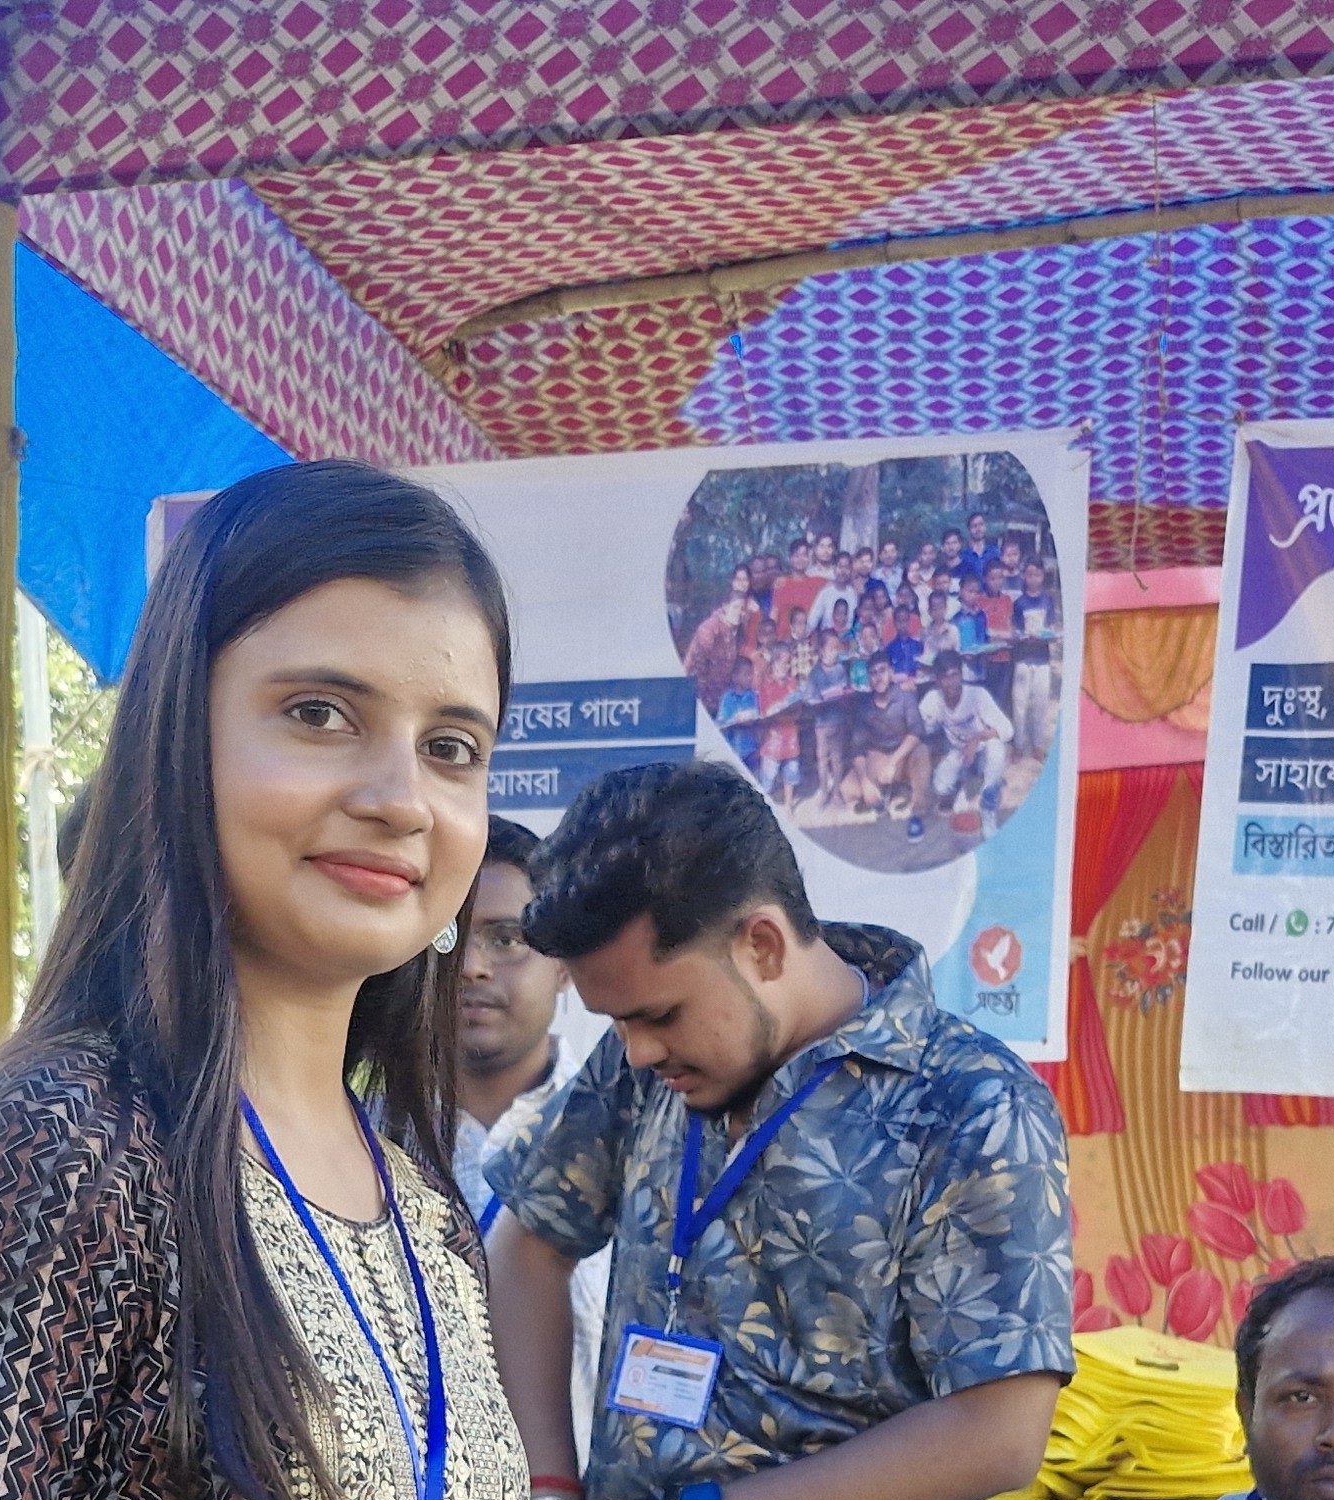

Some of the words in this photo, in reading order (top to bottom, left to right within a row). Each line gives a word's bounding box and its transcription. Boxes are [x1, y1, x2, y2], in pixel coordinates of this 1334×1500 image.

[579, 697, 642, 728] পাশে
[1262, 685, 1327, 727] দুঃস্থ,
[487, 767, 562, 797] আমরা
[1229, 913, 1265, 934] Call
[1230, 961, 1292, 982] Follow
[1298, 966, 1331, 983] our
